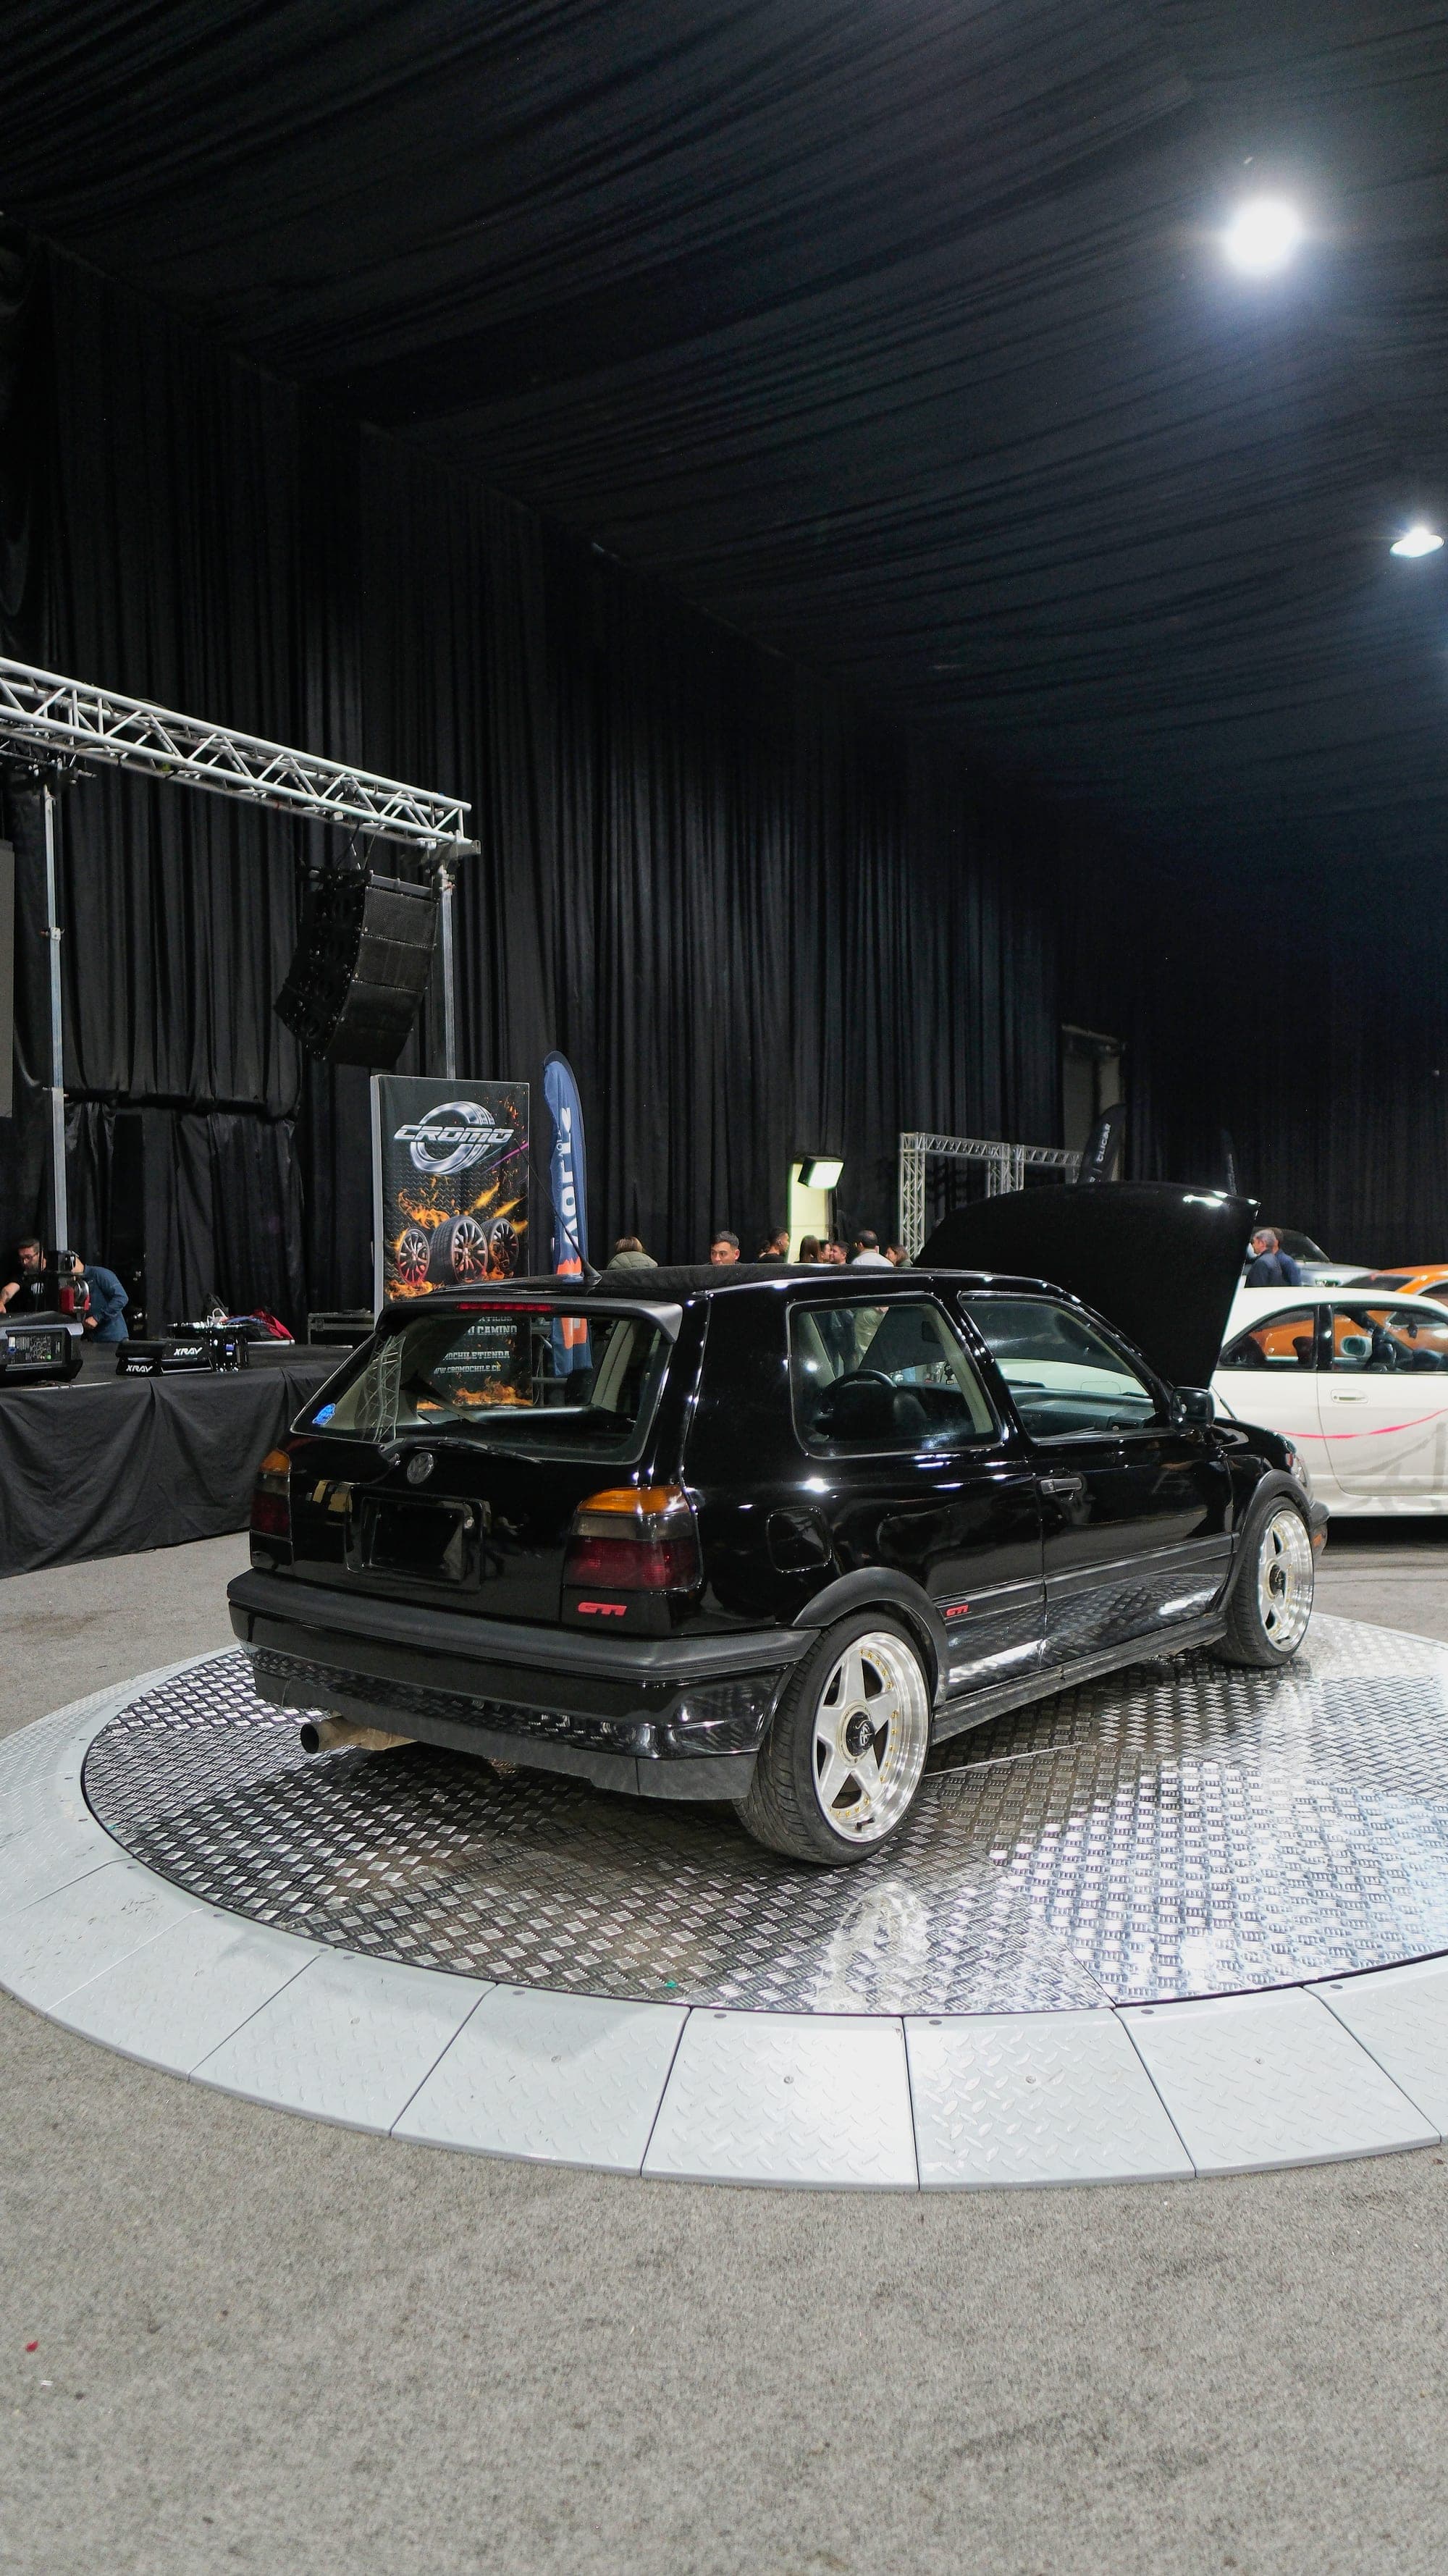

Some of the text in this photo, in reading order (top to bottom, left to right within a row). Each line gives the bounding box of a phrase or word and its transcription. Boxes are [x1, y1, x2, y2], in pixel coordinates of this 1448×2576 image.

[394, 1124, 515, 1142] CROMO
[477, 1325, 518, 1335] CAMINO
[442, 1350, 510, 1360] OCHILETIENDA
[578, 1602, 627, 1616] GTI
